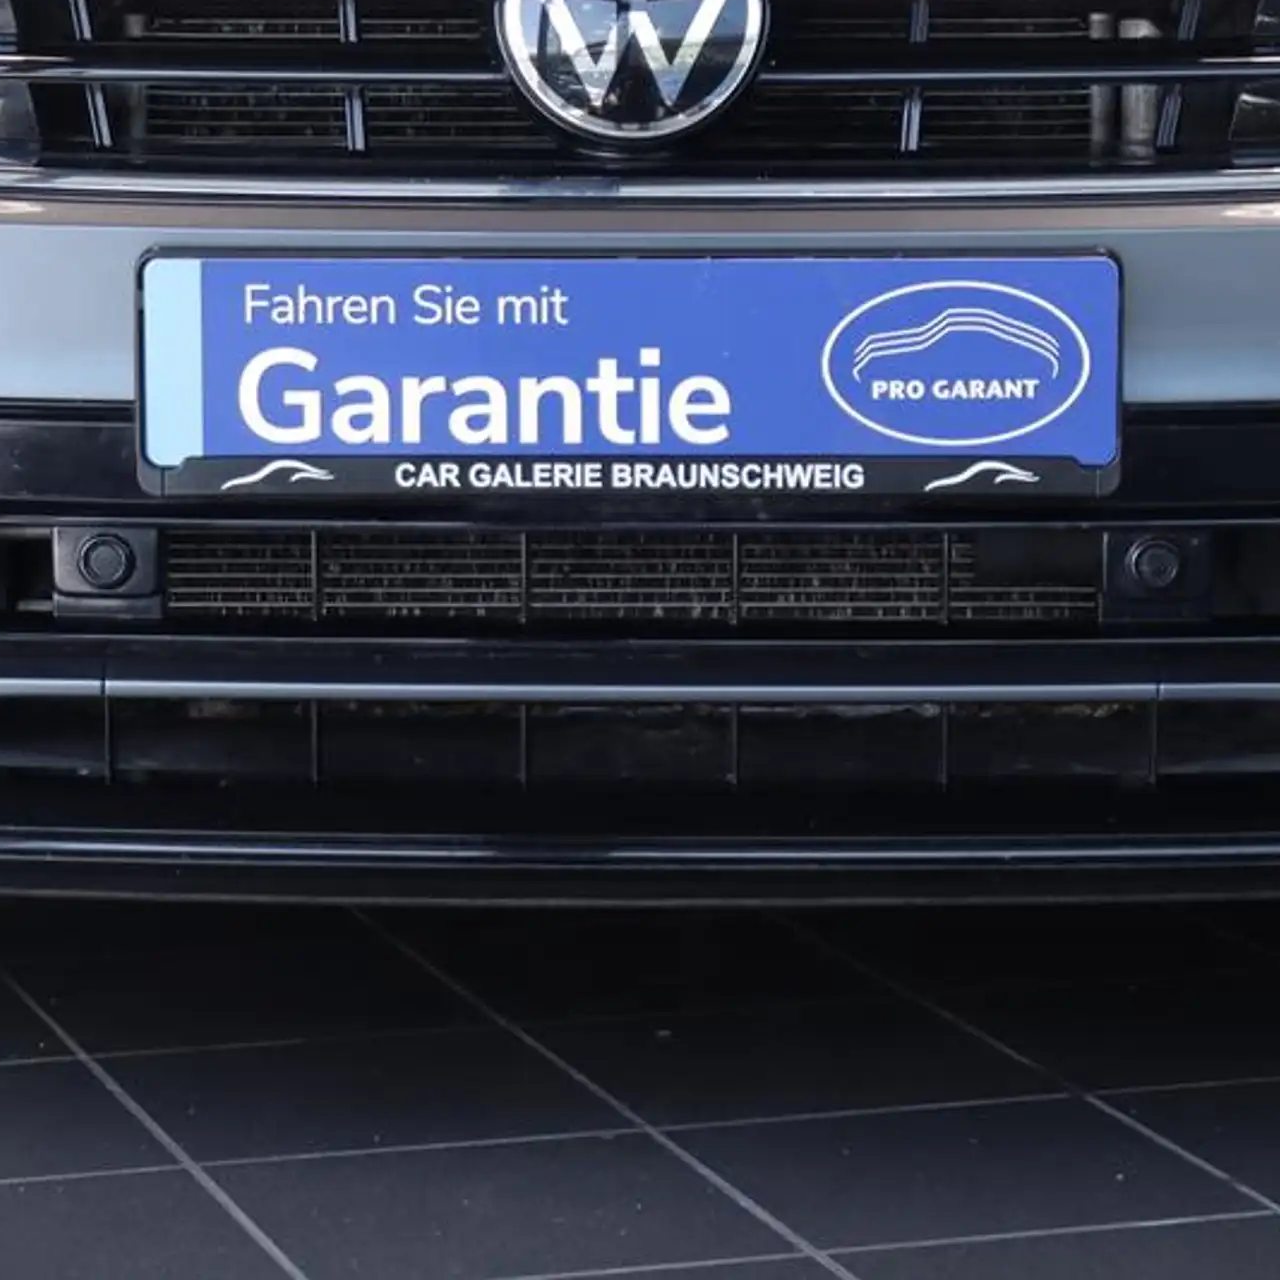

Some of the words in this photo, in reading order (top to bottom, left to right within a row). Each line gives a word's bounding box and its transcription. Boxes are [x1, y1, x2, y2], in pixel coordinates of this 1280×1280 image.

[243, 283, 396, 325] Fahren
[412, 283, 481, 325] Sie
[496, 283, 569, 325] mit
[237, 346, 731, 445] Garantie
[871, 378, 926, 400] PRO
[931, 378, 1040, 401] GARANT
[393, 461, 462, 490] CAR
[468, 461, 603, 490] GALERIE
[610, 461, 865, 490] BRAUNSCHWEIG
